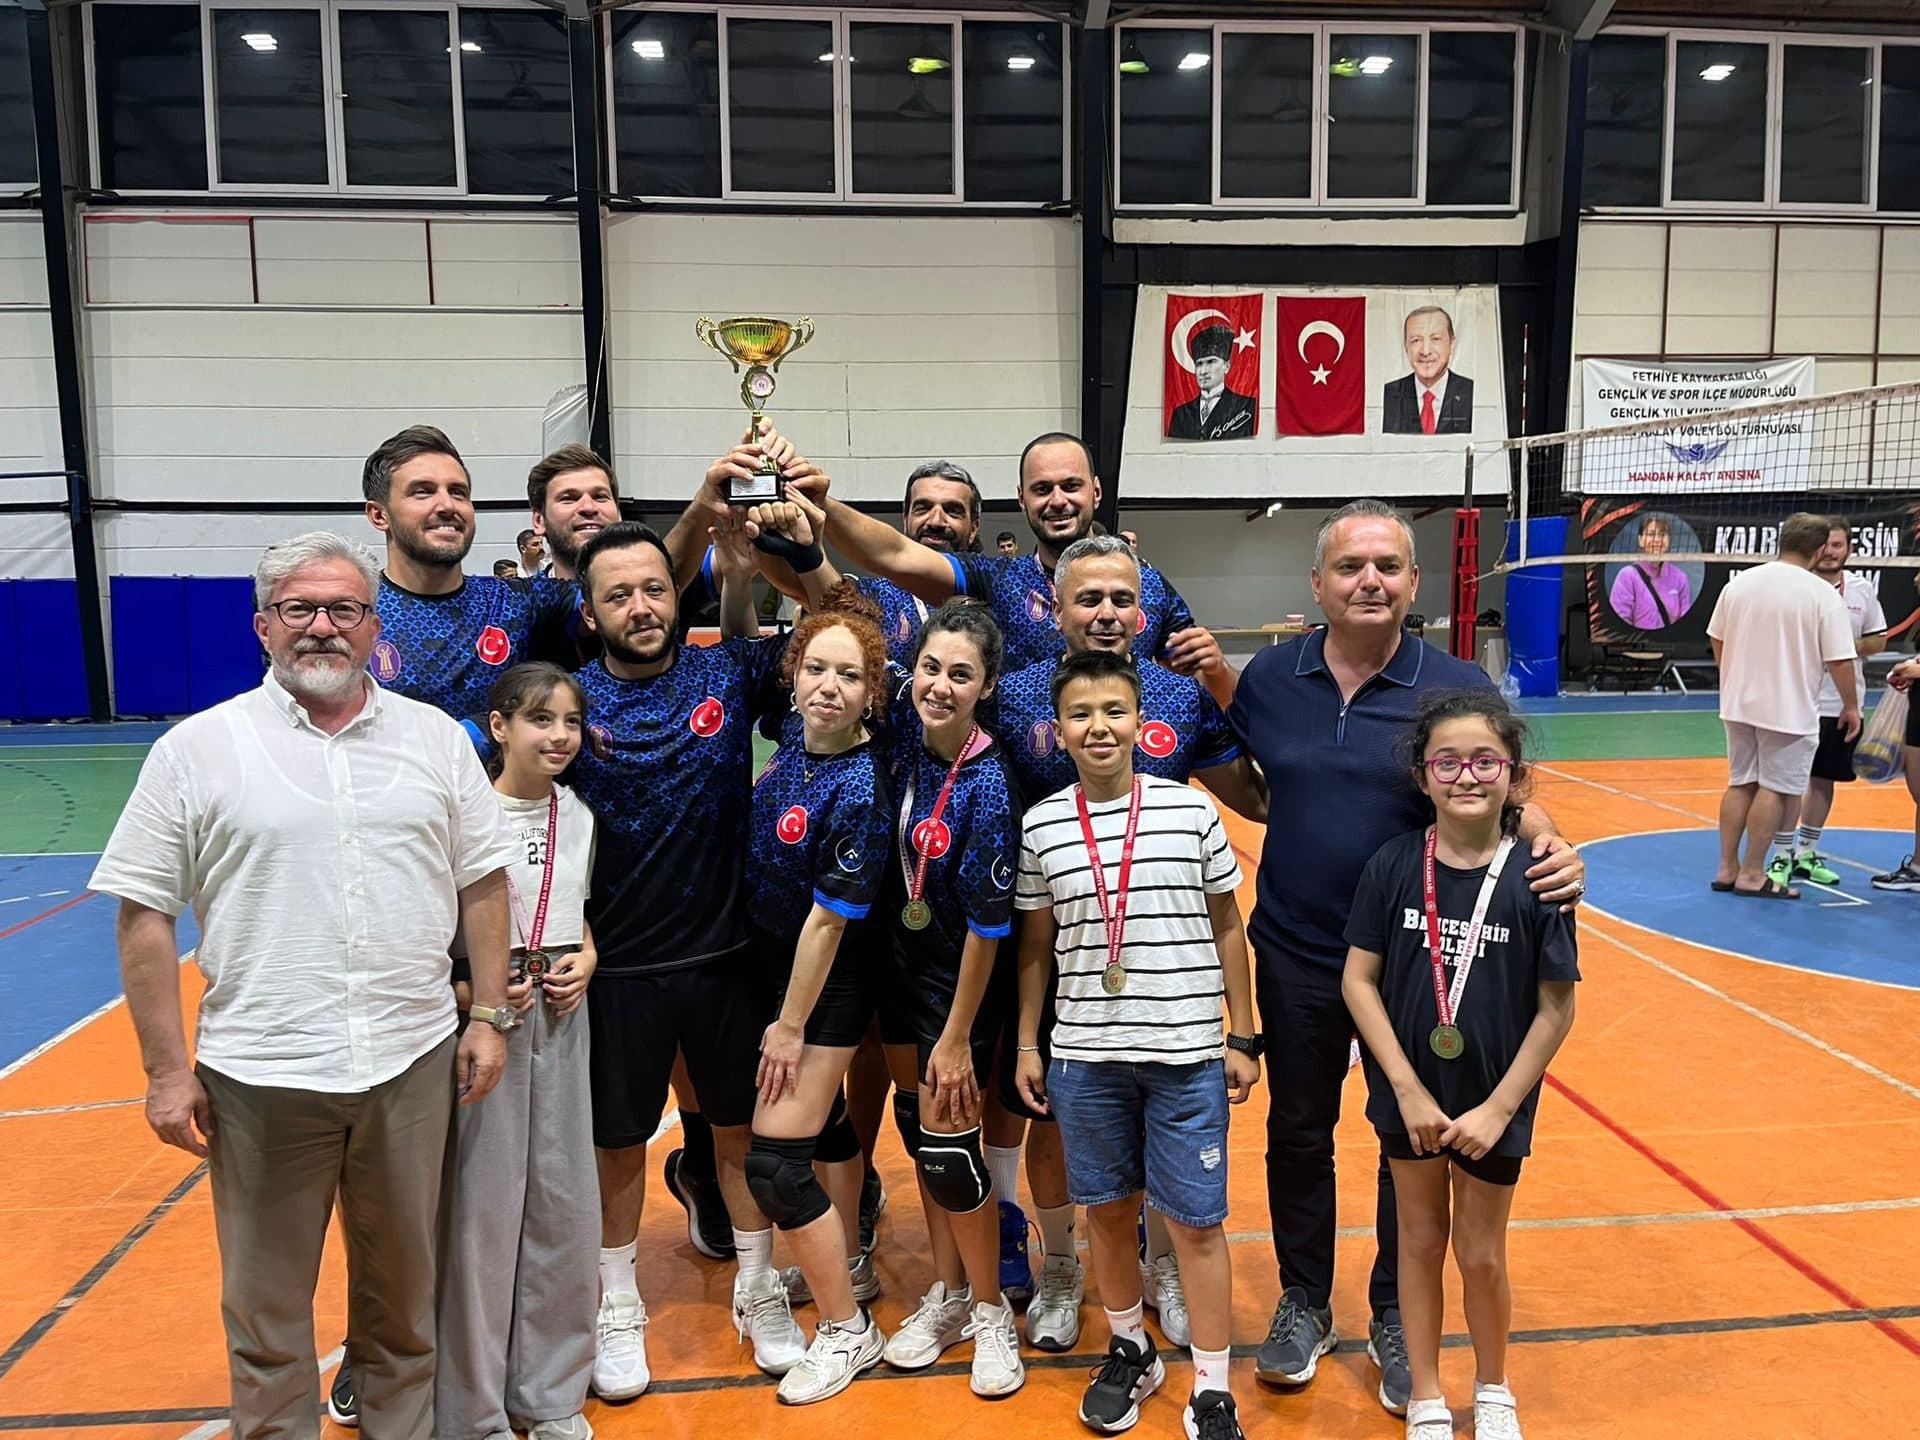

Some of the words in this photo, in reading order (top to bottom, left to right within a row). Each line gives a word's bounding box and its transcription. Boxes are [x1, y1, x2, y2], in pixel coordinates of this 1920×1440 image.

[1632, 370, 1678, 383] FETHİYE
[1681, 369, 1768, 383] KAYMAKAMLIĞI
[1598, 387, 1648, 402] GENÇLİK
[1651, 389, 1668, 400] VE
[1669, 389, 1700, 400] SPOR
[1702, 388, 1727, 402] İLÇE
[1729, 384, 1797, 399] MÜDÜRLÜĞÜ
[1610, 406, 1660, 420] GENÇLİK
[1663, 407, 1684, 417] YILI
[1680, 424, 1738, 436] VOLEYBOL
[1741, 423, 1801, 436] TURNUVASI
[1628, 471, 1673, 482] HANDAN
[1674, 471, 1713, 482] KALAY
[1717, 469, 1761, 481] ANISINA
[1403, 908, 1510, 943] BAÇEŞHİR
